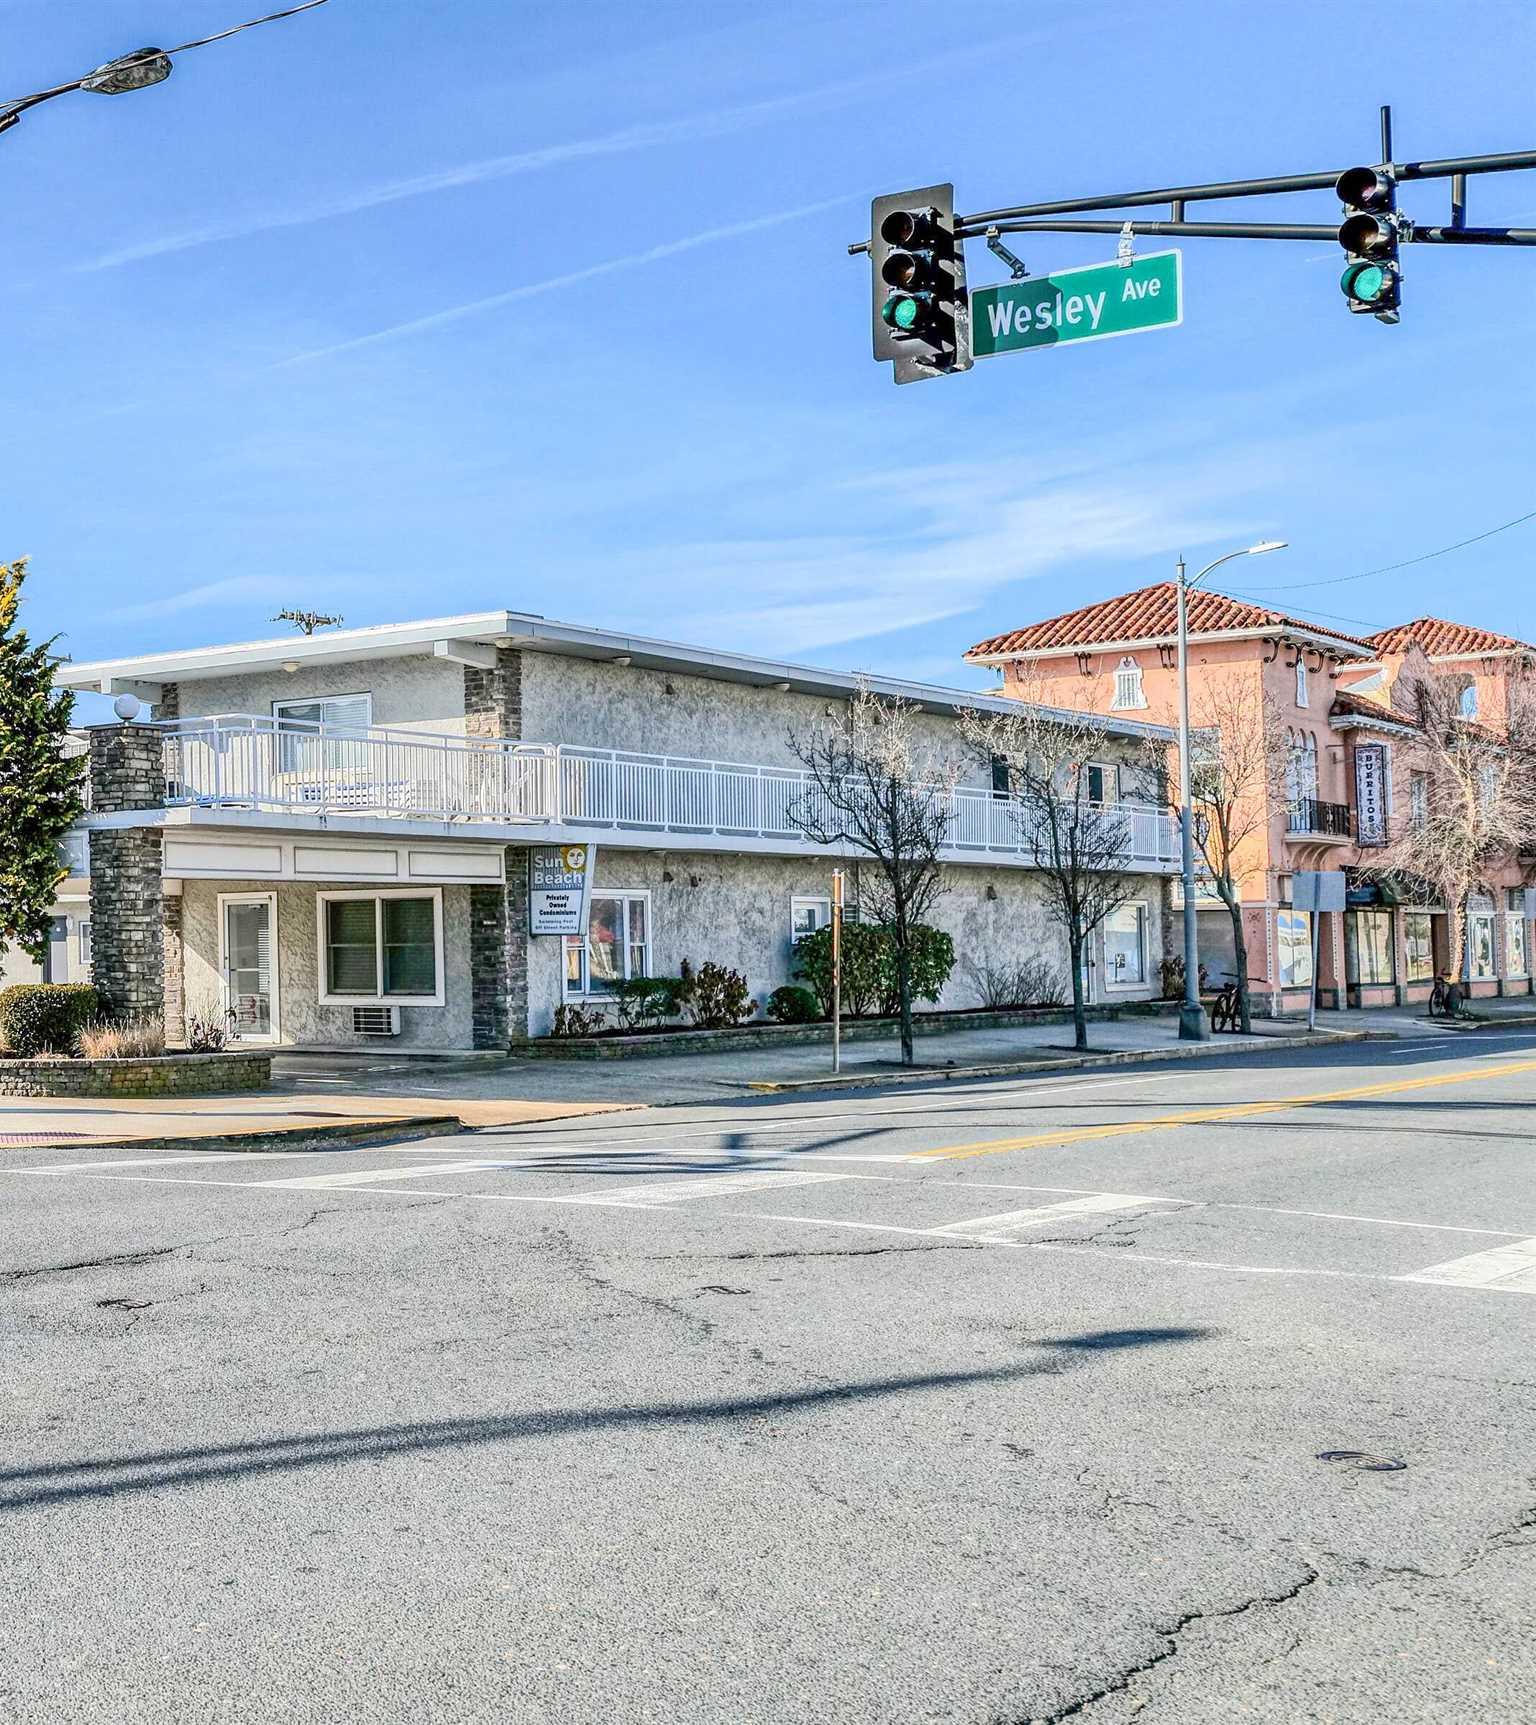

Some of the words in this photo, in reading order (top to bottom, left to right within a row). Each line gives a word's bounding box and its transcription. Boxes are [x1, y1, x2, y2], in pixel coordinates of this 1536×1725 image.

[987, 291, 1106, 338] Wesley
[1121, 277, 1162, 302] Ave
[1365, 754, 1375, 823] BURRITOS
[534, 855, 563, 868] Sun
[534, 871, 582, 885] Beach
[546, 894, 569, 902] Privately
